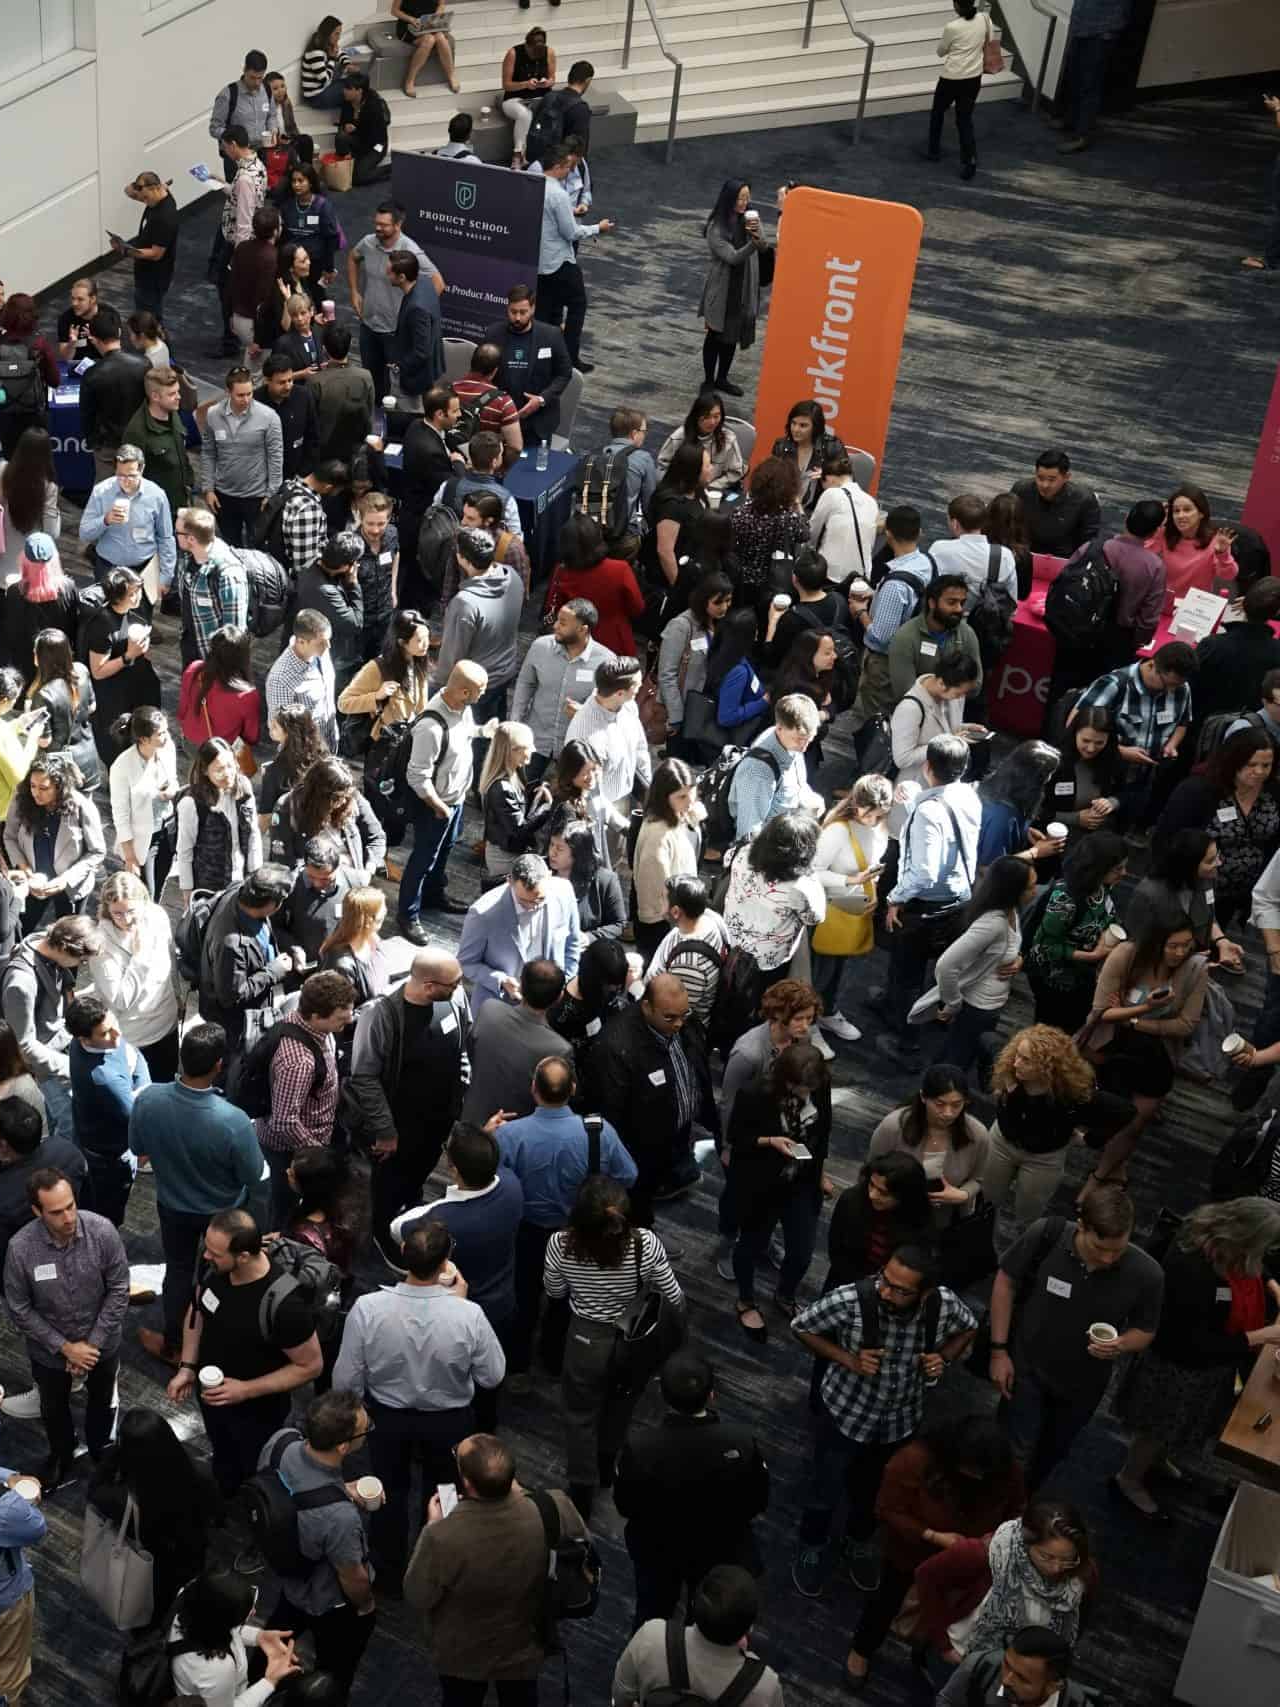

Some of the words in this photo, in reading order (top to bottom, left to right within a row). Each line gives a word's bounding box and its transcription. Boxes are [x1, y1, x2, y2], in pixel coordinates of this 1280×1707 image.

[419, 209, 466, 226] PRODUCT
[469, 219, 511, 235] SCHOOL
[434, 226, 463, 237] SILICON
[466, 232, 493, 242] VALLEY
[450, 284, 484, 300] Product
[806, 255, 862, 437] orkfront
